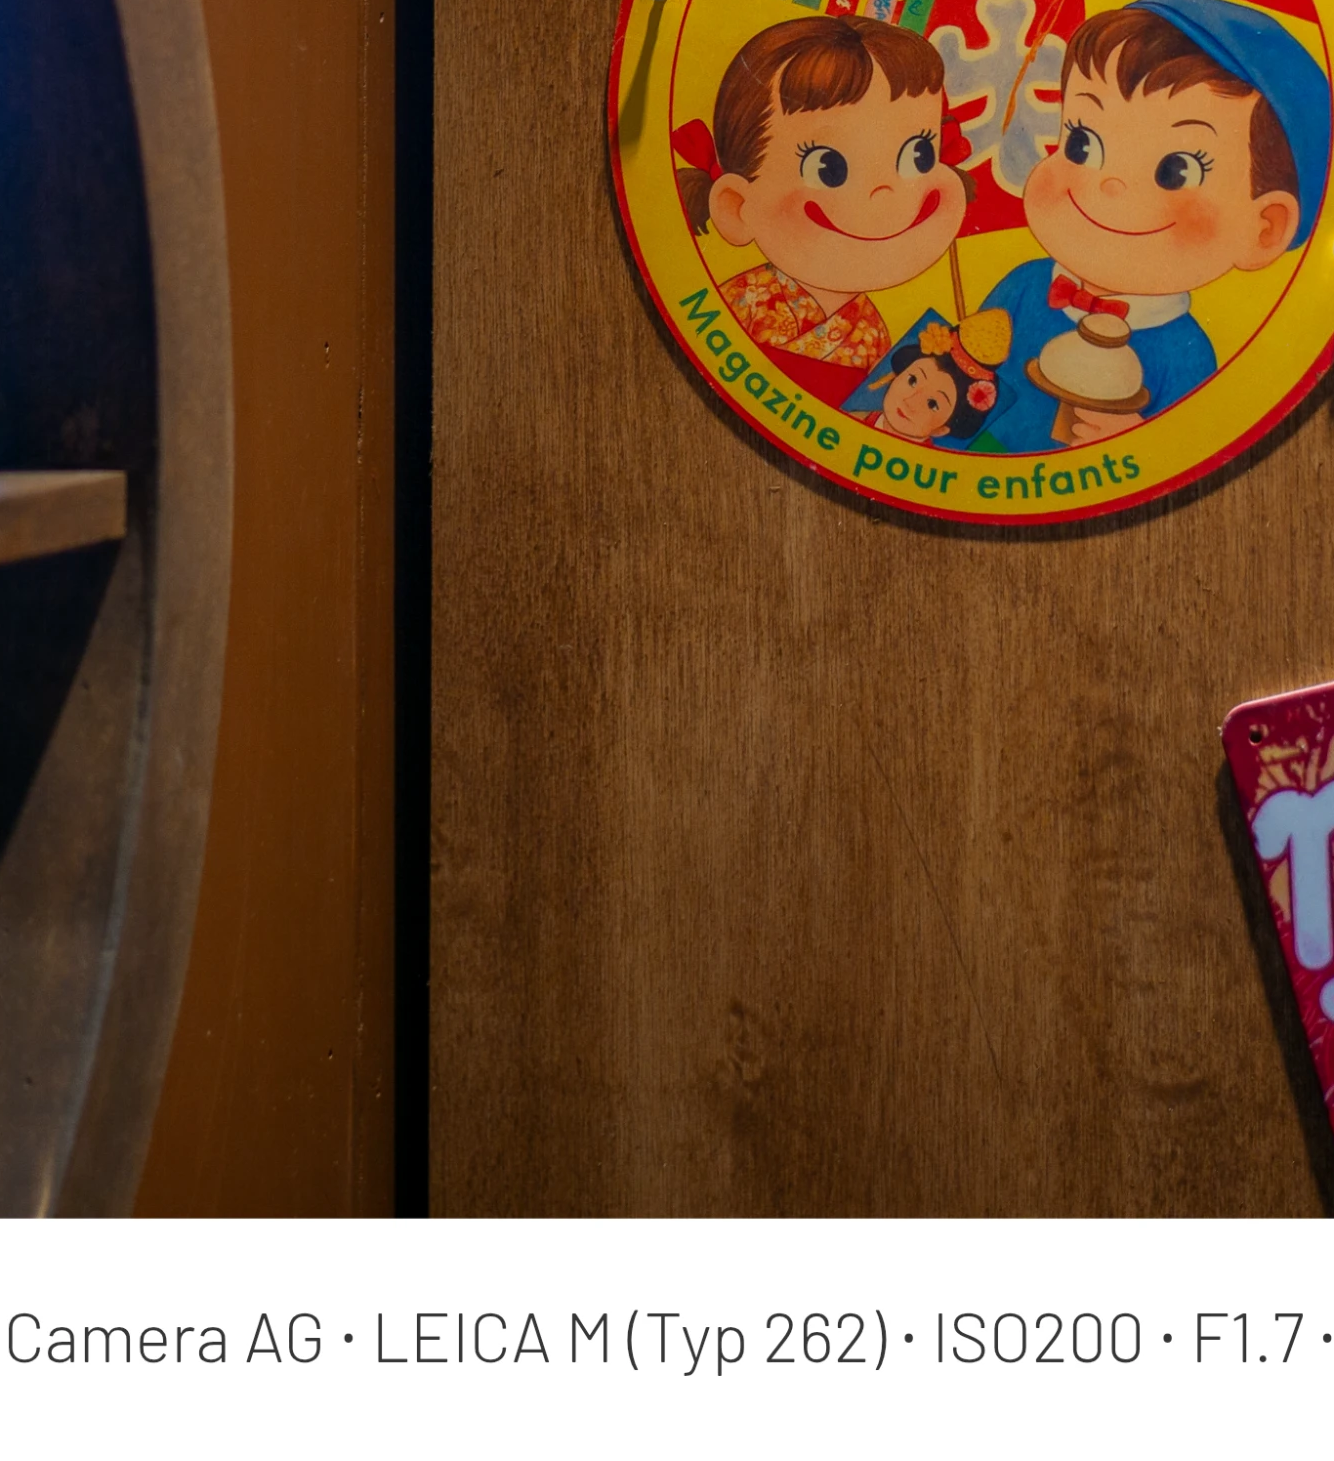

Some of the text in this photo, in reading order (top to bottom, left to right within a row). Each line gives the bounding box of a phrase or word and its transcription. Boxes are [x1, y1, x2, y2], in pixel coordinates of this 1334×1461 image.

[680, 288, 1142, 500] Magazine pour enfants
